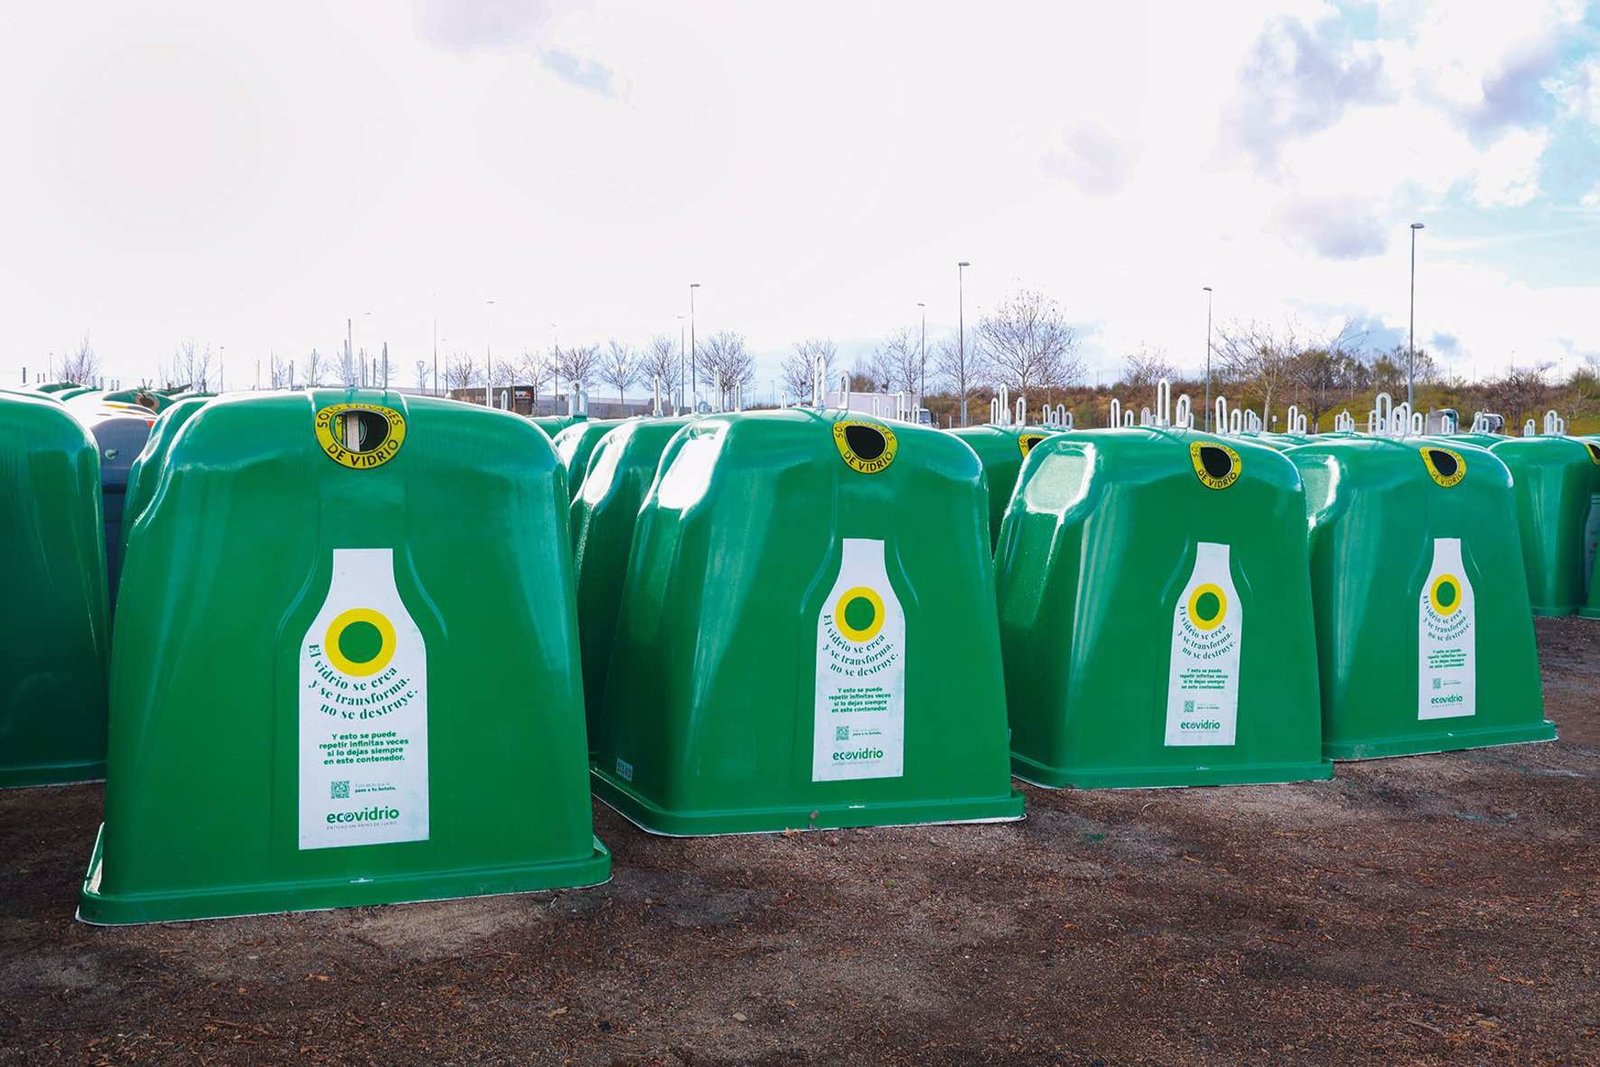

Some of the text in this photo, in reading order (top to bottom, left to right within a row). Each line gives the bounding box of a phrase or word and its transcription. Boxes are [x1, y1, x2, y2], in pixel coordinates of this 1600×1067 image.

[327, 439, 399, 467] DE VIDRIO
[844, 451, 893, 472] DE VIDRIO
[1198, 470, 1236, 487] DE VIDRIO
[824, 615, 832, 626] El
[827, 628, 851, 652] vidrio
[866, 635, 885, 651] crea
[831, 650, 840, 659] se
[841, 644, 894, 665] transforma.
[309, 644, 397, 691] El vidrio se crea
[830, 663, 842, 673] no
[858, 653, 899, 676] destruye.
[308, 678, 410, 706] y se transforma.
[1431, 694, 1462, 704] ecovidrio
[320, 690, 418, 720] no se destruye.
[1180, 720, 1220, 729] ecovidrio
[371, 731, 396, 739] puede
[319, 741, 348, 749] repetir
[350, 739, 384, 748] infinitas
[346, 748, 368, 756] dejas
[356, 755, 405, 763] contenedor.
[833, 748, 883, 760] ecovidrio
[326, 806, 399, 823] ecovidrio
